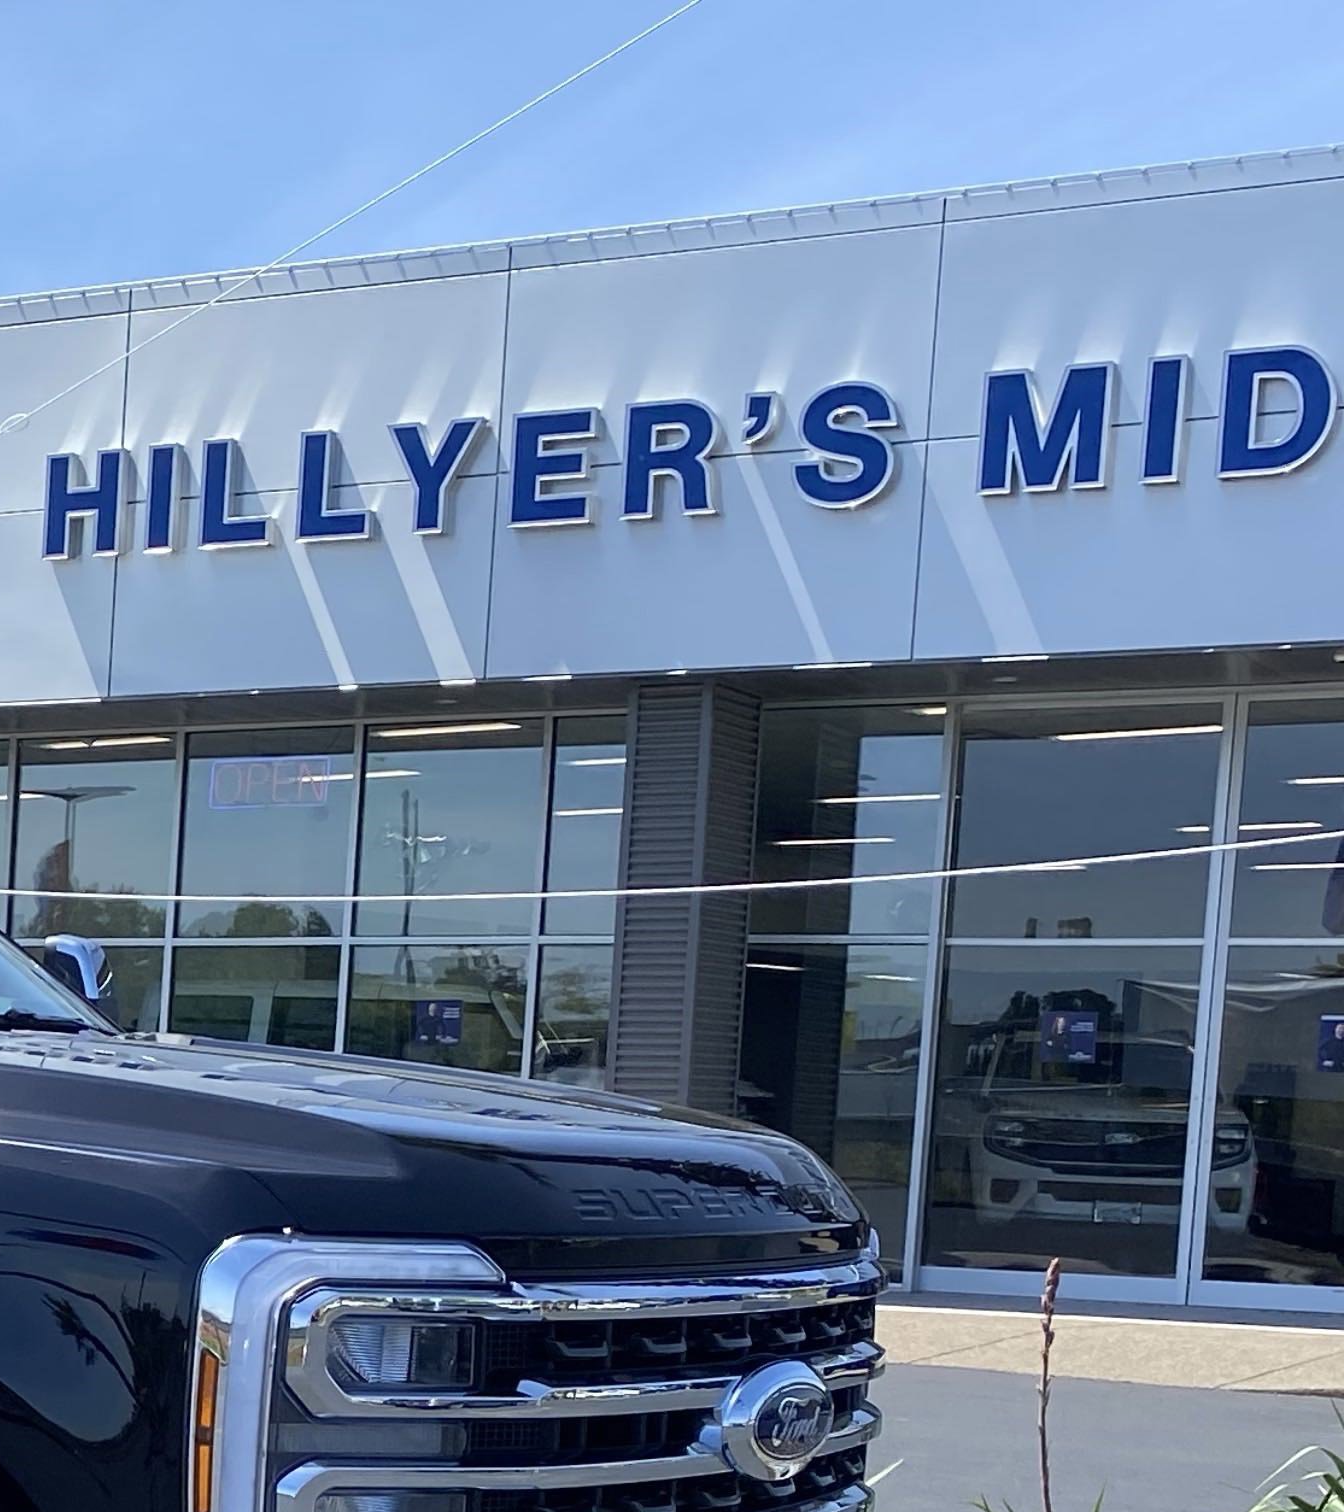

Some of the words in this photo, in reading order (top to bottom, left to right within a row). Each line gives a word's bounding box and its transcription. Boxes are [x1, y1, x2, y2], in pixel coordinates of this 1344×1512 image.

[40, 380, 898, 560] HILLYER'S
[976, 345, 1337, 494] MID
[214, 763, 325, 804] OPEN
[572, 1188, 768, 1222] SUPER
[771, 1397, 820, 1447] Ford
